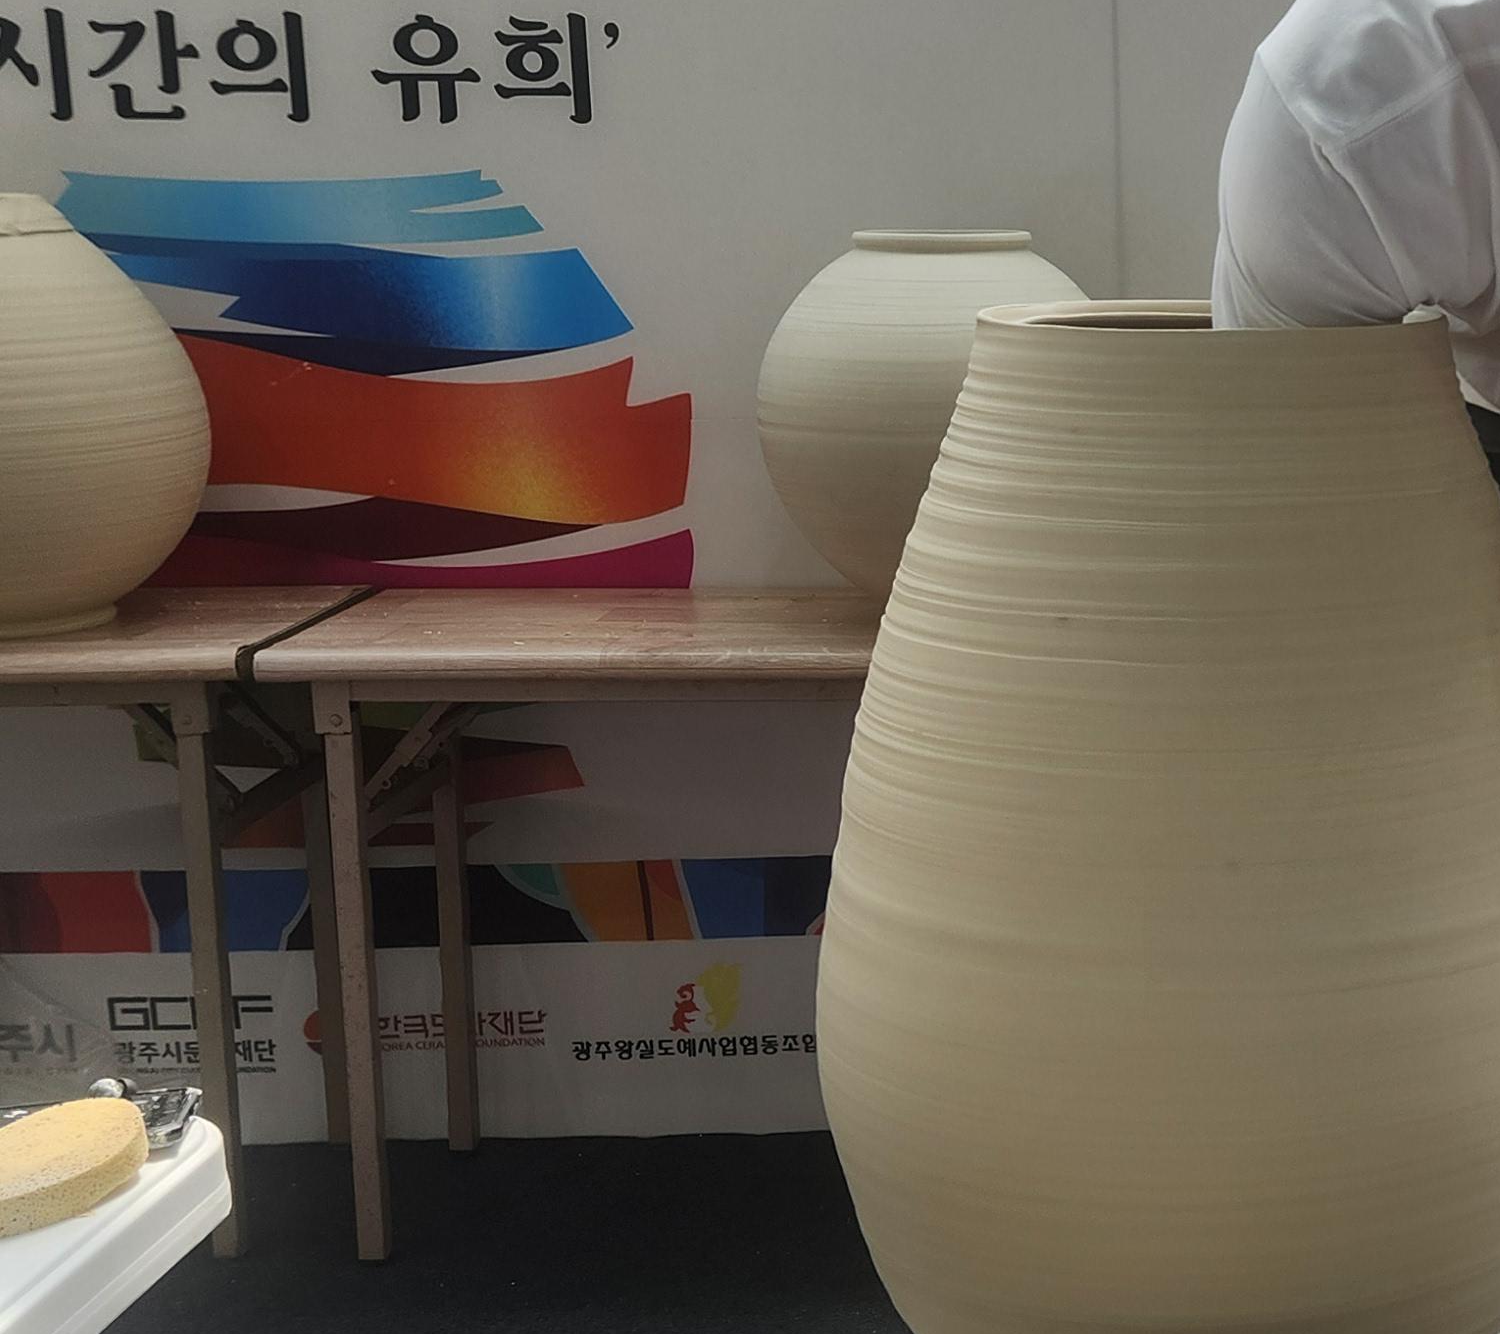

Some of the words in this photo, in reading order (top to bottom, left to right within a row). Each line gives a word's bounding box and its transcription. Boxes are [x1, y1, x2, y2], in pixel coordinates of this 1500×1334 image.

[0, 7, 311, 124] 시간의
[107, 995, 274, 1031] GCF
[114, 1038, 277, 1064] 광주시문재단
[474, 1037, 546, 1048] OUNDATION
